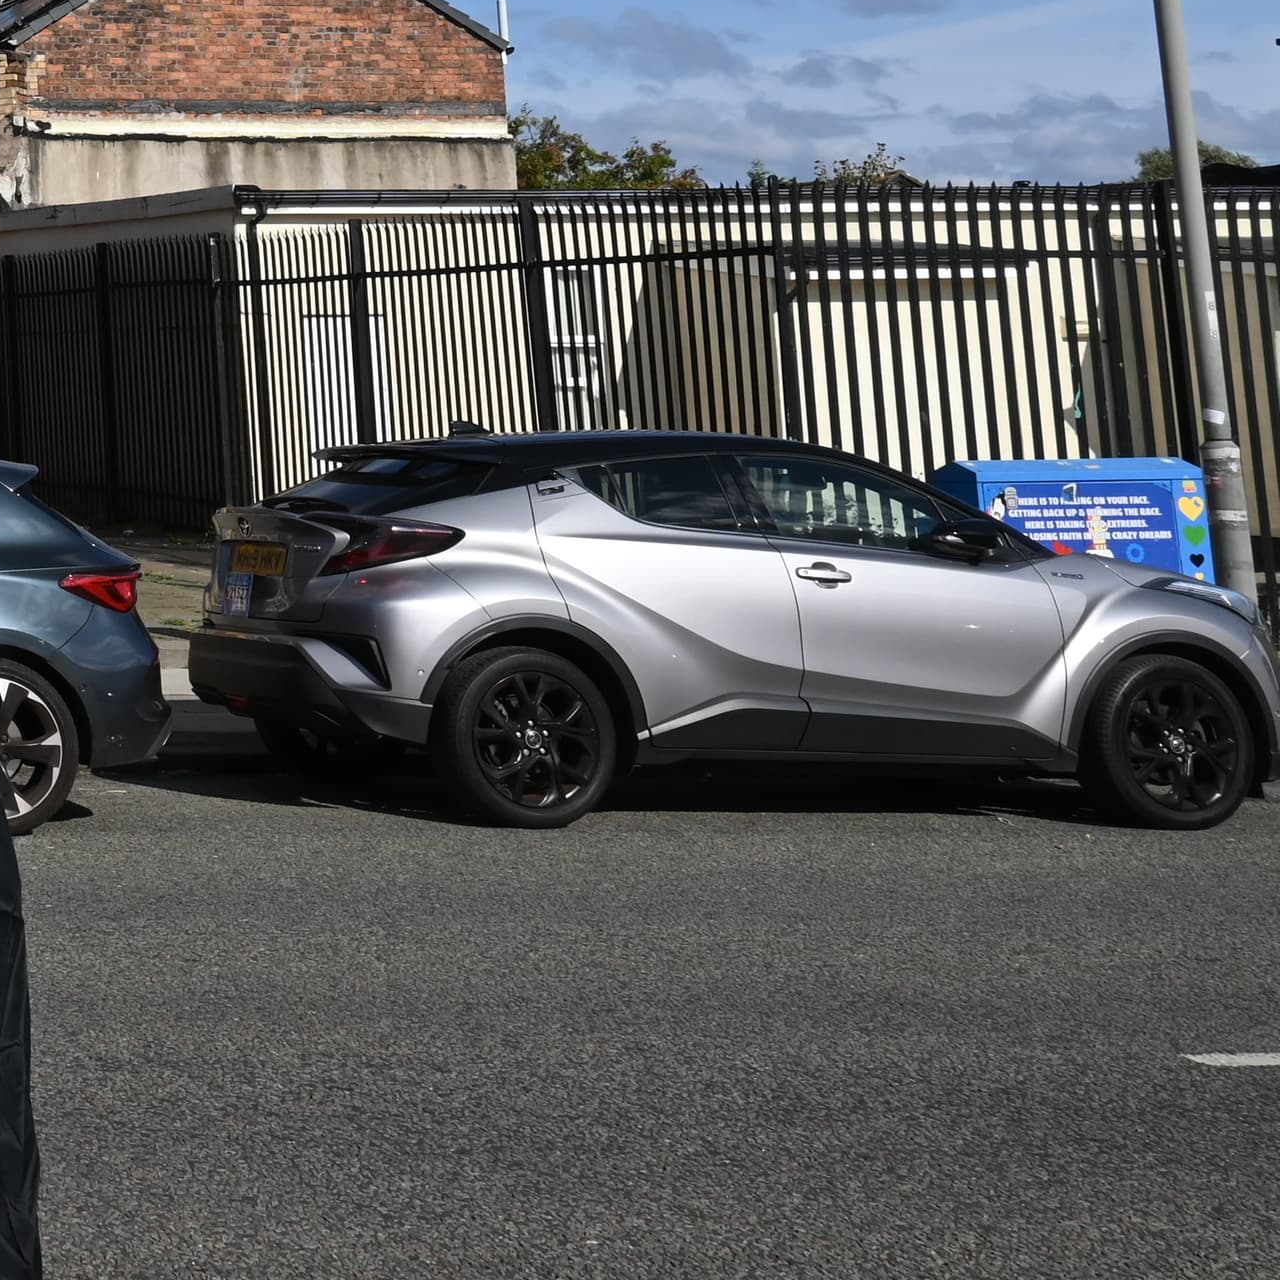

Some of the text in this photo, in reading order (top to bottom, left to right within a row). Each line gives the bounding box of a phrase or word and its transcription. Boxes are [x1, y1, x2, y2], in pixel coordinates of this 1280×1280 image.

[1039, 497, 1047, 506] IS
[1048, 497, 1059, 506] TO
[1093, 496, 1106, 505] ON
[1107, 496, 1128, 505] YOUR
[1008, 509, 1041, 518] GETTING
[1043, 509, 1064, 518] BACK
[1066, 509, 1078, 517] UP
[1124, 508, 1139, 516] THE
[1025, 521, 1045, 529] HERE
[1047, 521, 1054, 529] IS
[1055, 520, 1085, 529] TAKING
[1060, 532, 1082, 540] FAITH
[1112, 531, 1137, 540] CRAZY
[1139, 531, 1172, 539] DREAMS
